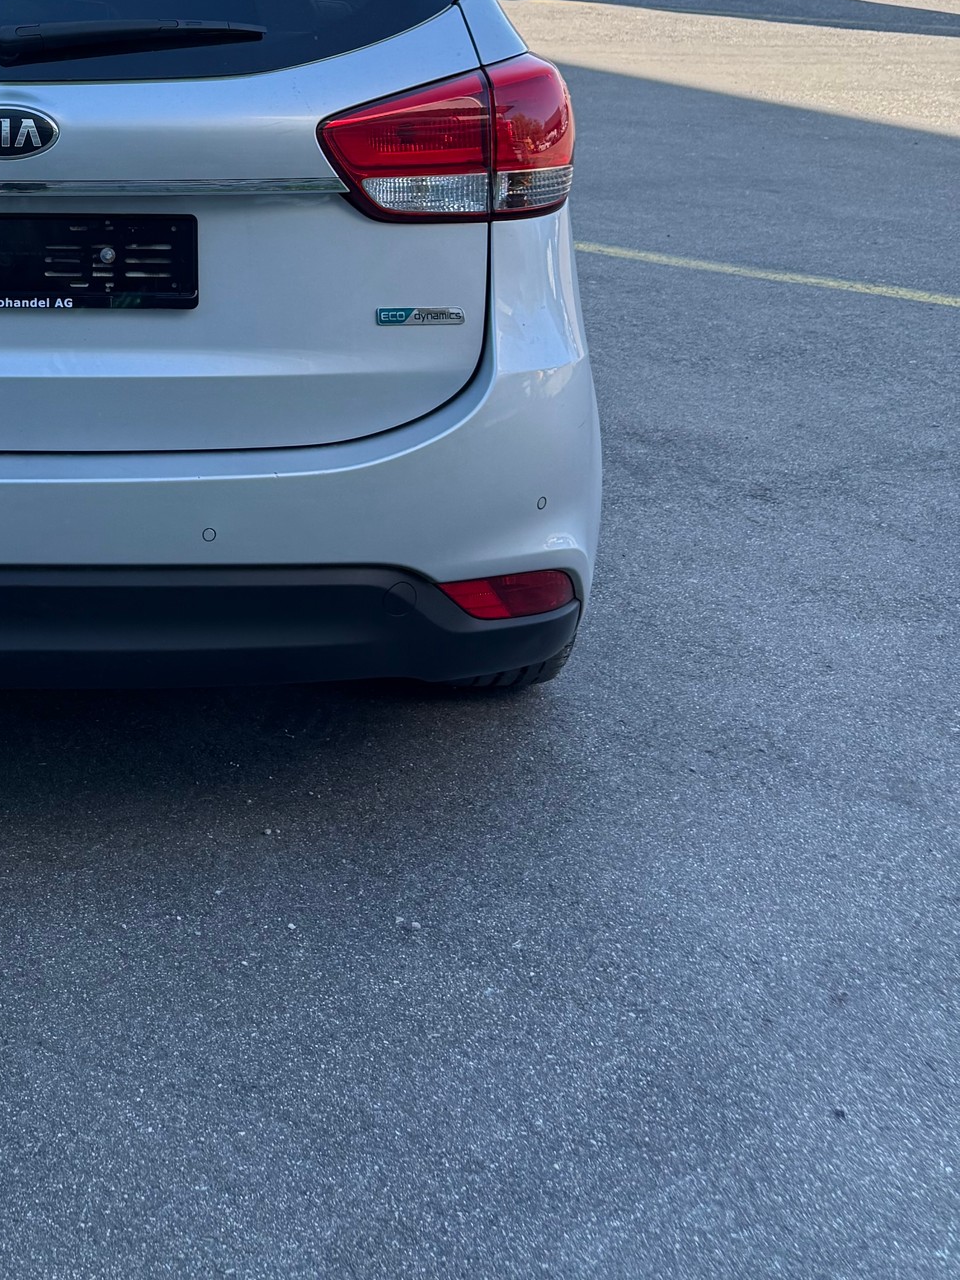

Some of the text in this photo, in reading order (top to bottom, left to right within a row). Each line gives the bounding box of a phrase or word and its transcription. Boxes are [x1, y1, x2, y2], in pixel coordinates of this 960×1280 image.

[54, 298, 73, 308] AG
[380, 311, 462, 323] ECO dynamics
